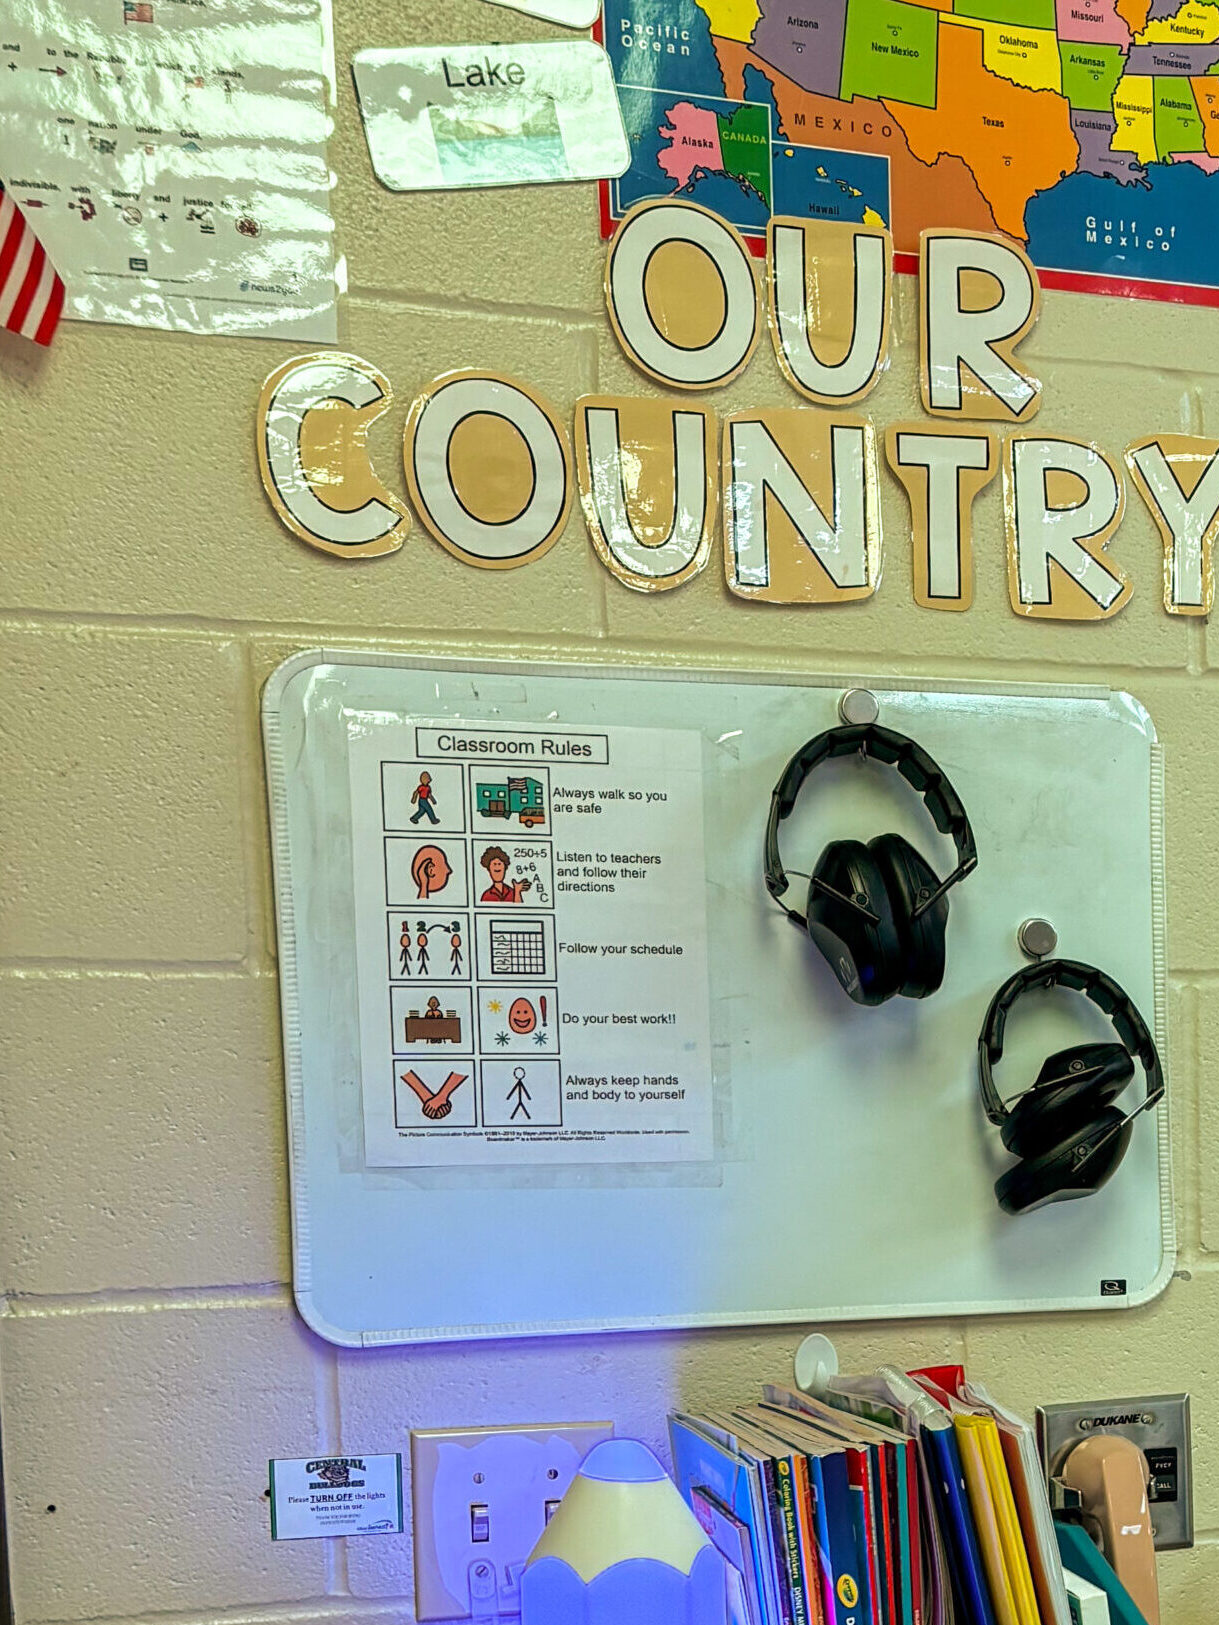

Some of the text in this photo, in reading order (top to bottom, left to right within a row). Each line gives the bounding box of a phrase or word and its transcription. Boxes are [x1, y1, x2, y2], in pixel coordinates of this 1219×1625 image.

[787, 16, 819, 29] Arizona
[1071, 10, 1104, 23] Missouri
[620, 19, 690, 41] Pacific
[1170, 22, 1205, 38] Kentucky
[621, 34, 691, 56] Ocean
[1000, 35, 1039, 49] Oklahoma
[63, 49, 79, 59] the
[871, 42, 919, 58] New Mexico
[1069, 54, 1106, 67] Arkansas
[1152, 56, 1192, 70] Tennessee
[441, 57, 527, 89] Lake
[1115, 101, 1152, 114] Mississippi
[1160, 97, 1192, 112] Alabama
[57, 117, 75, 125] one
[136, 125, 162, 136] under
[794, 113, 893, 138] MEXICO
[982, 116, 1005, 128] Texas
[1074, 118, 1112, 132] Louisiana
[682, 136, 714, 150] Alaska
[722, 130, 768, 145] CANADA
[71, 184, 91, 195] with
[154, 194, 171, 203] and
[183, 197, 214, 208] justice
[809, 203, 840, 216] Hawaii
[1086, 216, 1176, 238] Gulf of
[1086, 230, 1170, 252] Mexico
[608, 203, 1040, 420] OUR
[437, 735, 592, 757] Classroom Rules
[553, 787, 668, 804] Always walk so you
[554, 802, 602, 814] are safe
[513, 848, 548, 860] 250÷5
[556, 851, 662, 865] Listen to teachers
[532, 873, 541, 884] A
[557, 866, 647, 879] and follow their
[536, 883, 544, 893] B
[557, 881, 616, 893] directions
[540, 893, 549, 904] C
[559, 943, 683, 957] Follow your schedule
[562, 1012, 676, 1027] Do your best work!!
[566, 1075, 679, 1088] Always keep hands
[566, 1089, 685, 1102] and body to yourself
[1093, 1413, 1141, 1427] DUKANE
[306, 1459, 367, 1473] CENTRAL
[310, 1495, 334, 1503] TURN
[336, 1493, 353, 1502] OFF
[367, 1492, 386, 1501] lights
[782, 1479, 799, 1579] Coloring Book with Stickers
[793, 1587, 804, 1615] DISNEY
